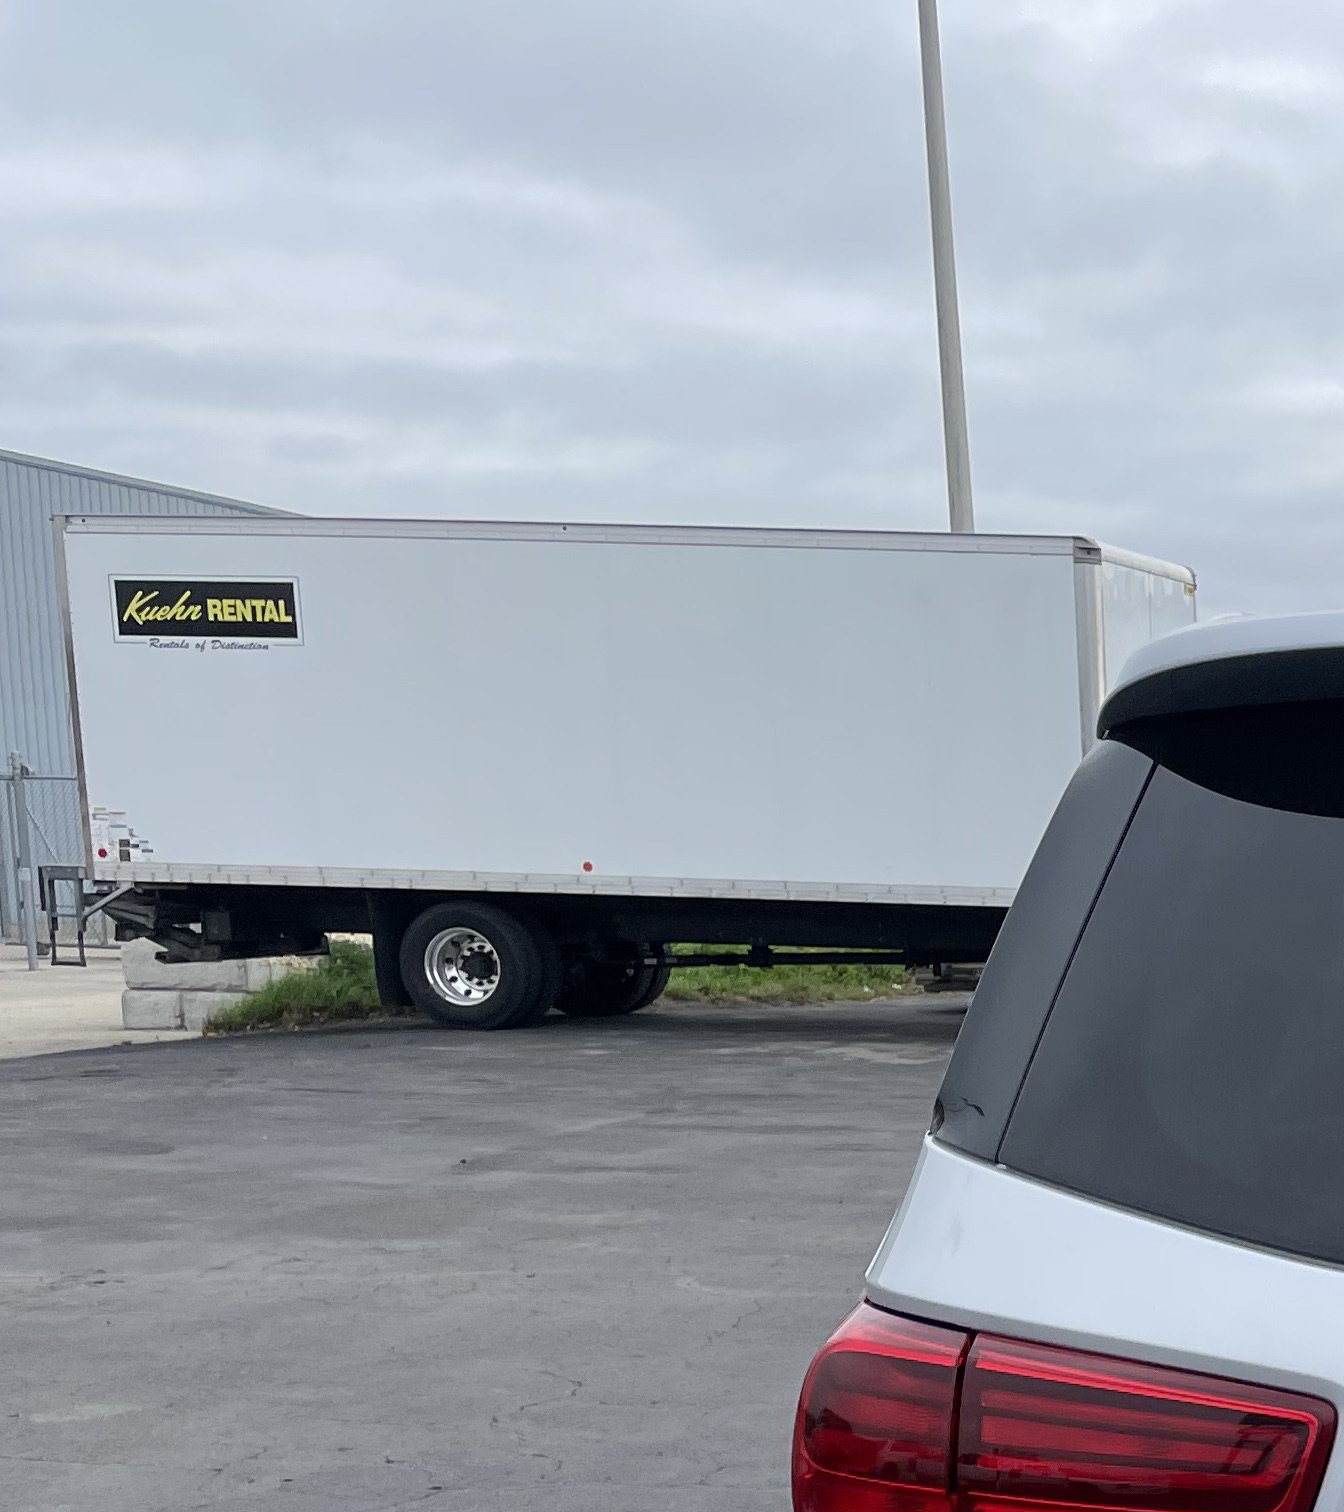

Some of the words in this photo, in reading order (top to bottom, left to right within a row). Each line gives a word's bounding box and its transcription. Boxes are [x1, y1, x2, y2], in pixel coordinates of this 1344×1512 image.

[123, 590, 202, 625] Kuehn
[206, 598, 293, 623] RENTAL
[149, 638, 190, 649] Rentals
[195, 639, 207, 652] of
[211, 640, 270, 650] Distinction
